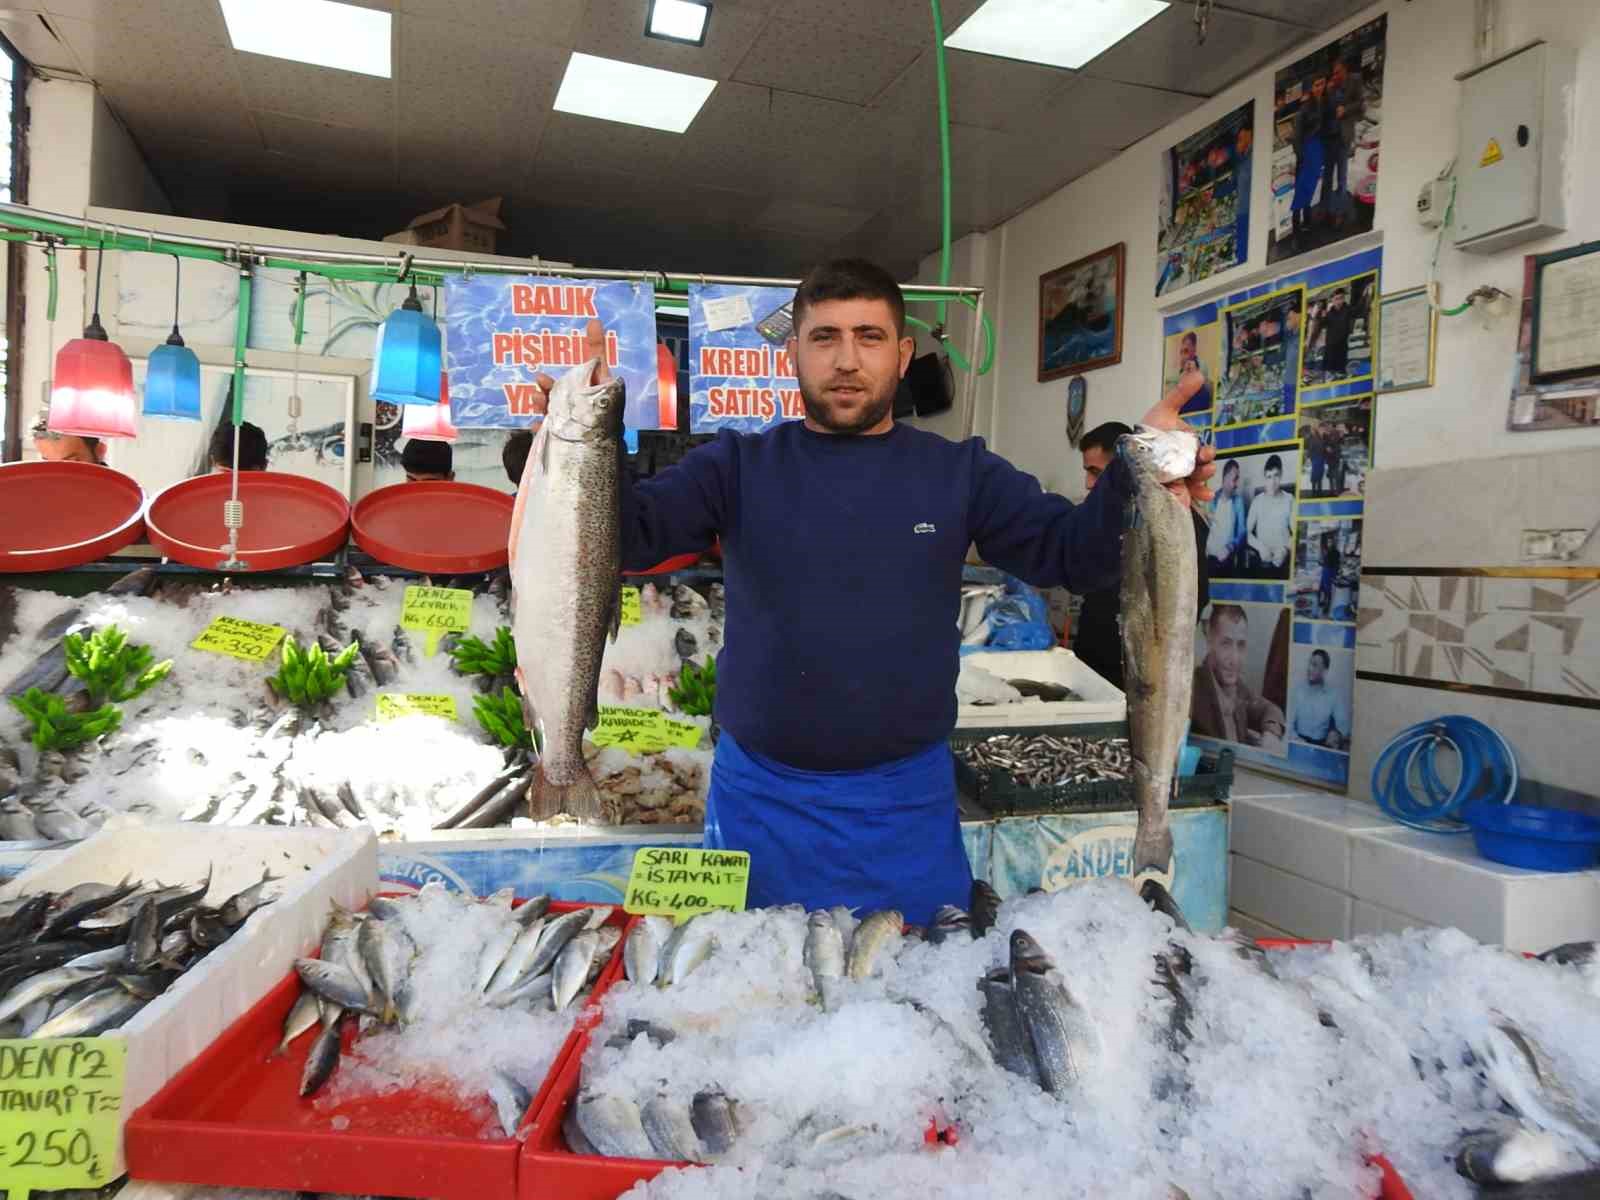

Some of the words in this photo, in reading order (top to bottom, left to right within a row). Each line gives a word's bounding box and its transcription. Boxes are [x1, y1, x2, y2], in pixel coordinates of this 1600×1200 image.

[512, 284, 598, 317] BALIK
[493, 328, 618, 371] PİŞİRİİ
[701, 345, 769, 377] KREDİ
[709, 387, 775, 422] SATIŞ
[642, 849, 689, 865] SARI
